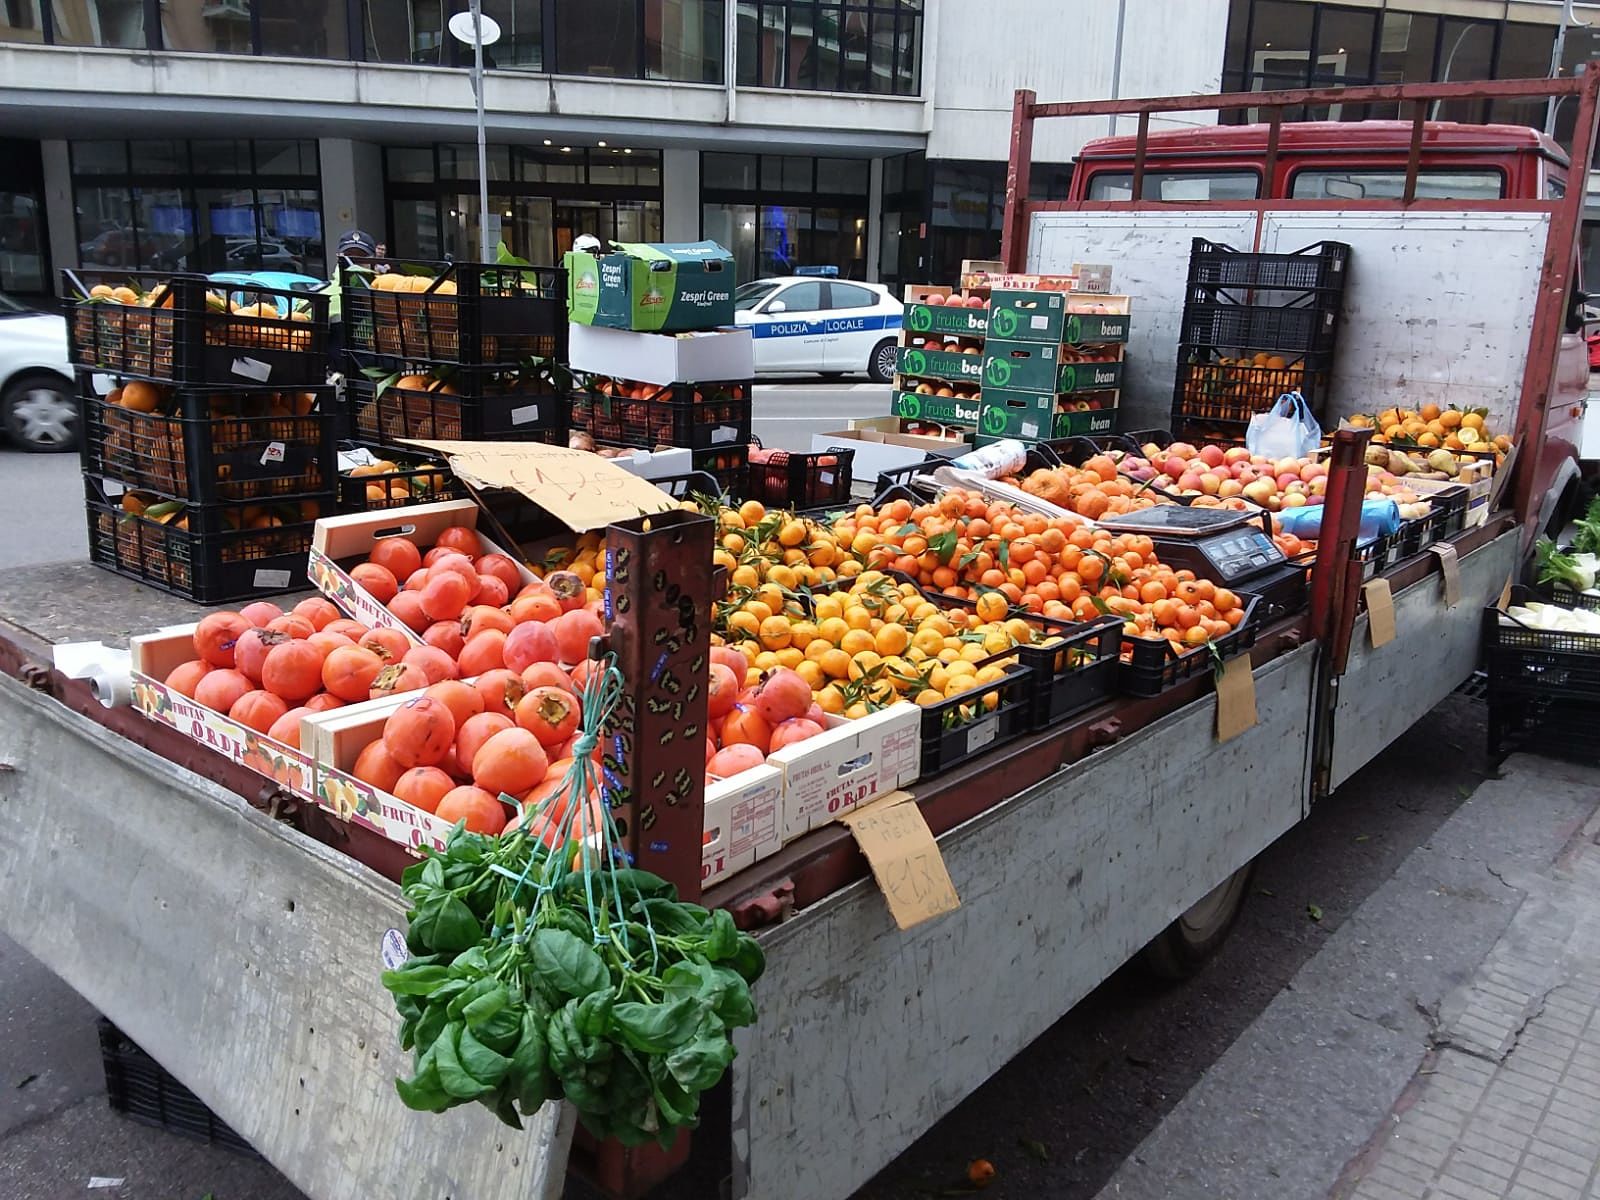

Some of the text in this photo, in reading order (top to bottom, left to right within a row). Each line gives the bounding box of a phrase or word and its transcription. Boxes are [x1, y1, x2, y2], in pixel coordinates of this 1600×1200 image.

[601, 264, 622, 277] Zespri
[602, 273, 622, 283] Green
[1003, 281, 1035, 290] ORDI
[680, 290, 729, 303] Zespri Green
[771, 319, 864, 335] POLIZIA LOCALE
[1101, 320, 1122, 336] bean
[1095, 368, 1115, 384] bean
[1090, 416, 1111, 431] bean
[356, 595, 393, 627] FRUTAS
[172, 702, 205, 721] FRUTAS
[825, 778, 855, 799] FRUTAS
[827, 780, 879, 813] ORDI
